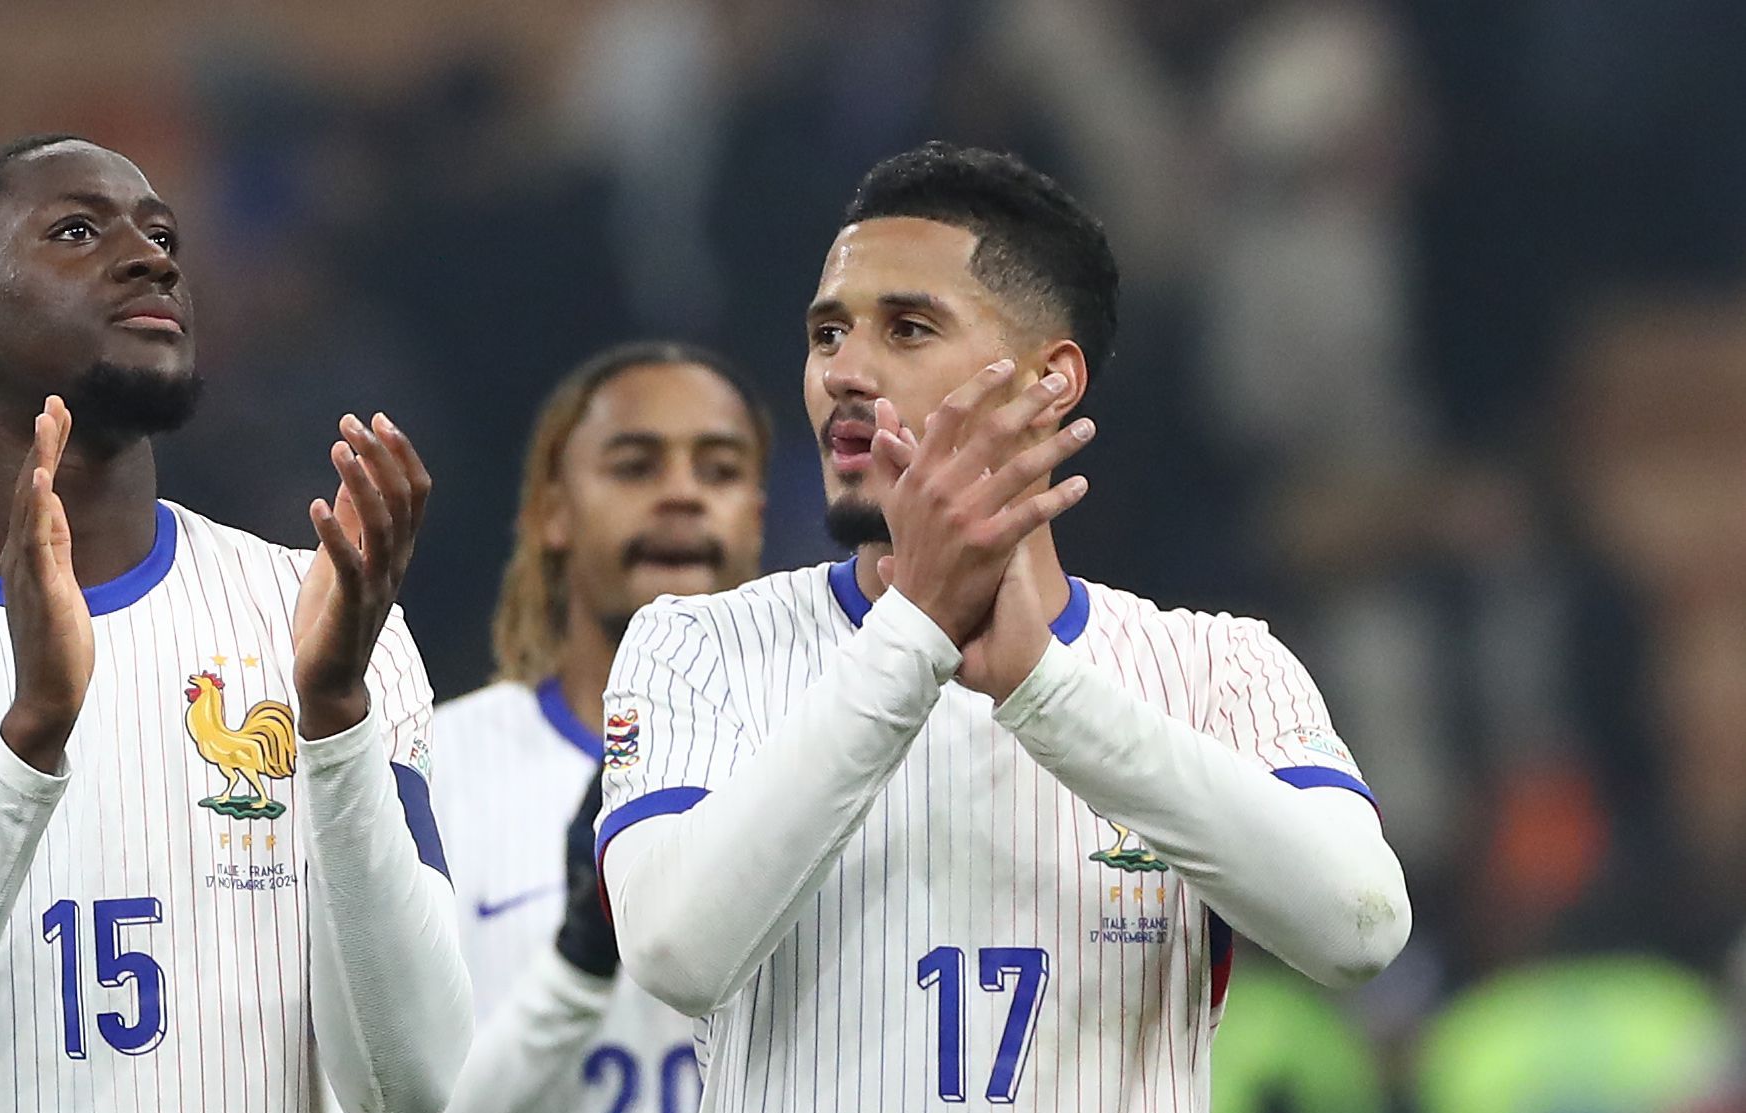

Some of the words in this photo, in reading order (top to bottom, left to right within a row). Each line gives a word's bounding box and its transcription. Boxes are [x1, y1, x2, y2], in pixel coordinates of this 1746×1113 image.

[217, 864, 238, 876] ITALIE
[250, 864, 284, 877] FRANCE
[205, 876, 214, 887] 17
[218, 877, 266, 890] NOVEMBRE
[269, 875, 297, 889] 2024
[1102, 918, 1126, 929] ITALIE
[1090, 931, 1099, 942] 17
[1102, 931, 1152, 943] NOVEMBRE
[42, 897, 168, 1060] 15
[917, 945, 1050, 1104] 17
